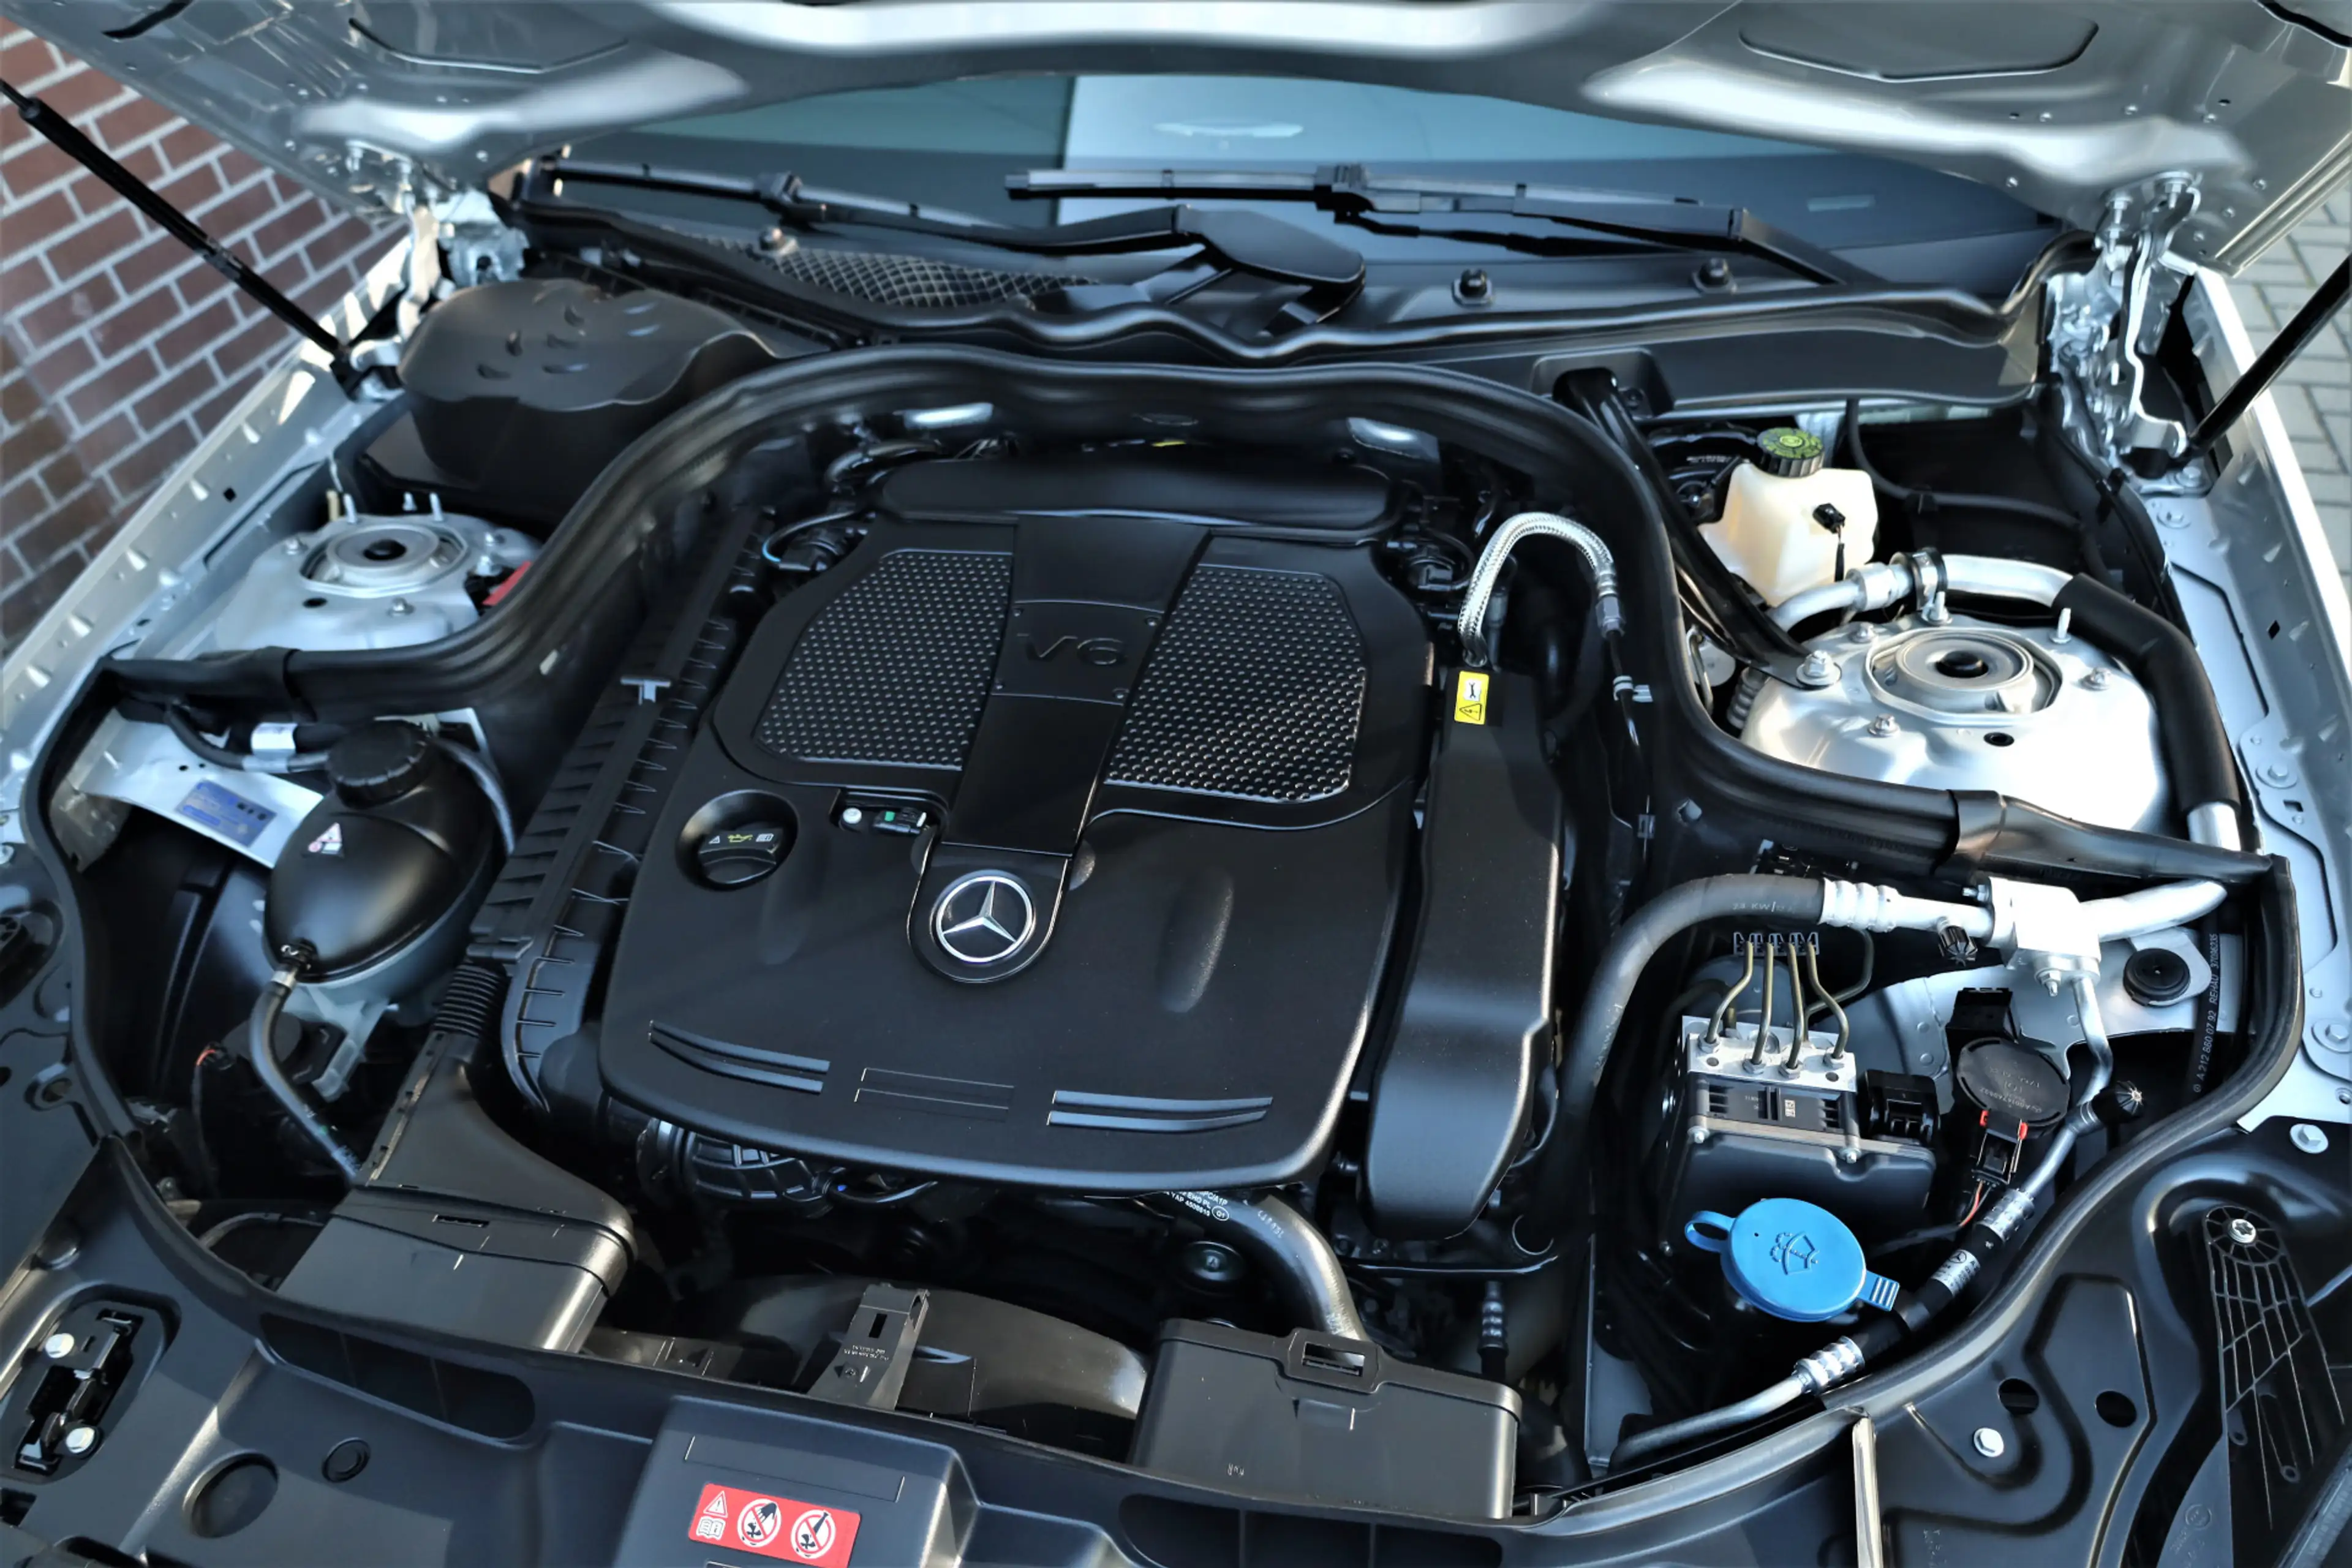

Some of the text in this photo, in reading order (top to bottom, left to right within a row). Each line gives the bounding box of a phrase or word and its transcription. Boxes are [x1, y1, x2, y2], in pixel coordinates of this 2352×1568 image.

[1017, 634, 1128, 666] V6
[2209, 974, 2219, 1005] REHAU
[2207, 1010, 2217, 1022] 92
[2206, 1023, 2215, 1035] 07
[2198, 1054, 2210, 1072] 212
